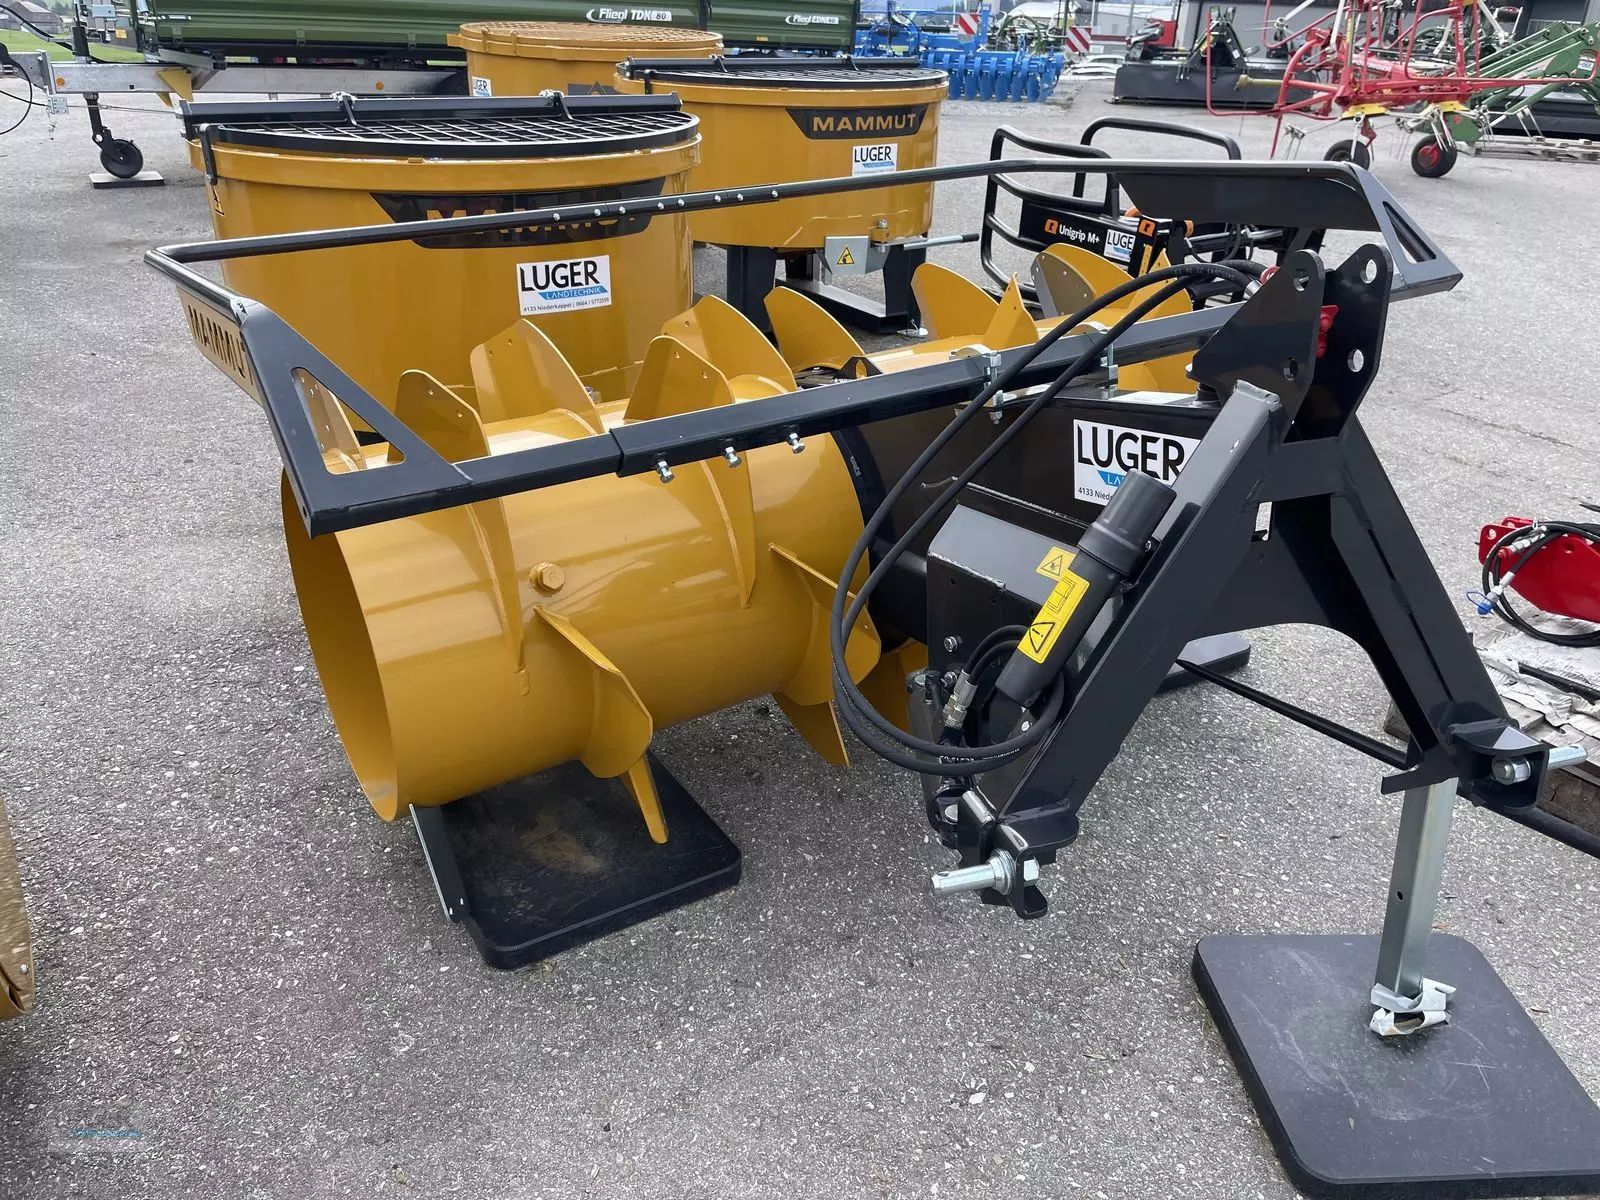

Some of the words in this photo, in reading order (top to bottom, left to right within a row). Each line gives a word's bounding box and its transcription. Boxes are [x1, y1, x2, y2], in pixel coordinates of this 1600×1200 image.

[599, 8, 628, 21] Fliegl
[813, 114, 916, 131] MAMMUT
[854, 146, 891, 162] LUGER
[1059, 224, 1086, 242] Unigrip
[1087, 232, 1100, 244] M+
[1108, 231, 1134, 250] LUGE
[520, 260, 600, 292] LUGER
[546, 287, 601, 299] LANDTECHNIK
[1077, 423, 1184, 481] LUGER
[1079, 486, 1094, 496] 4133
